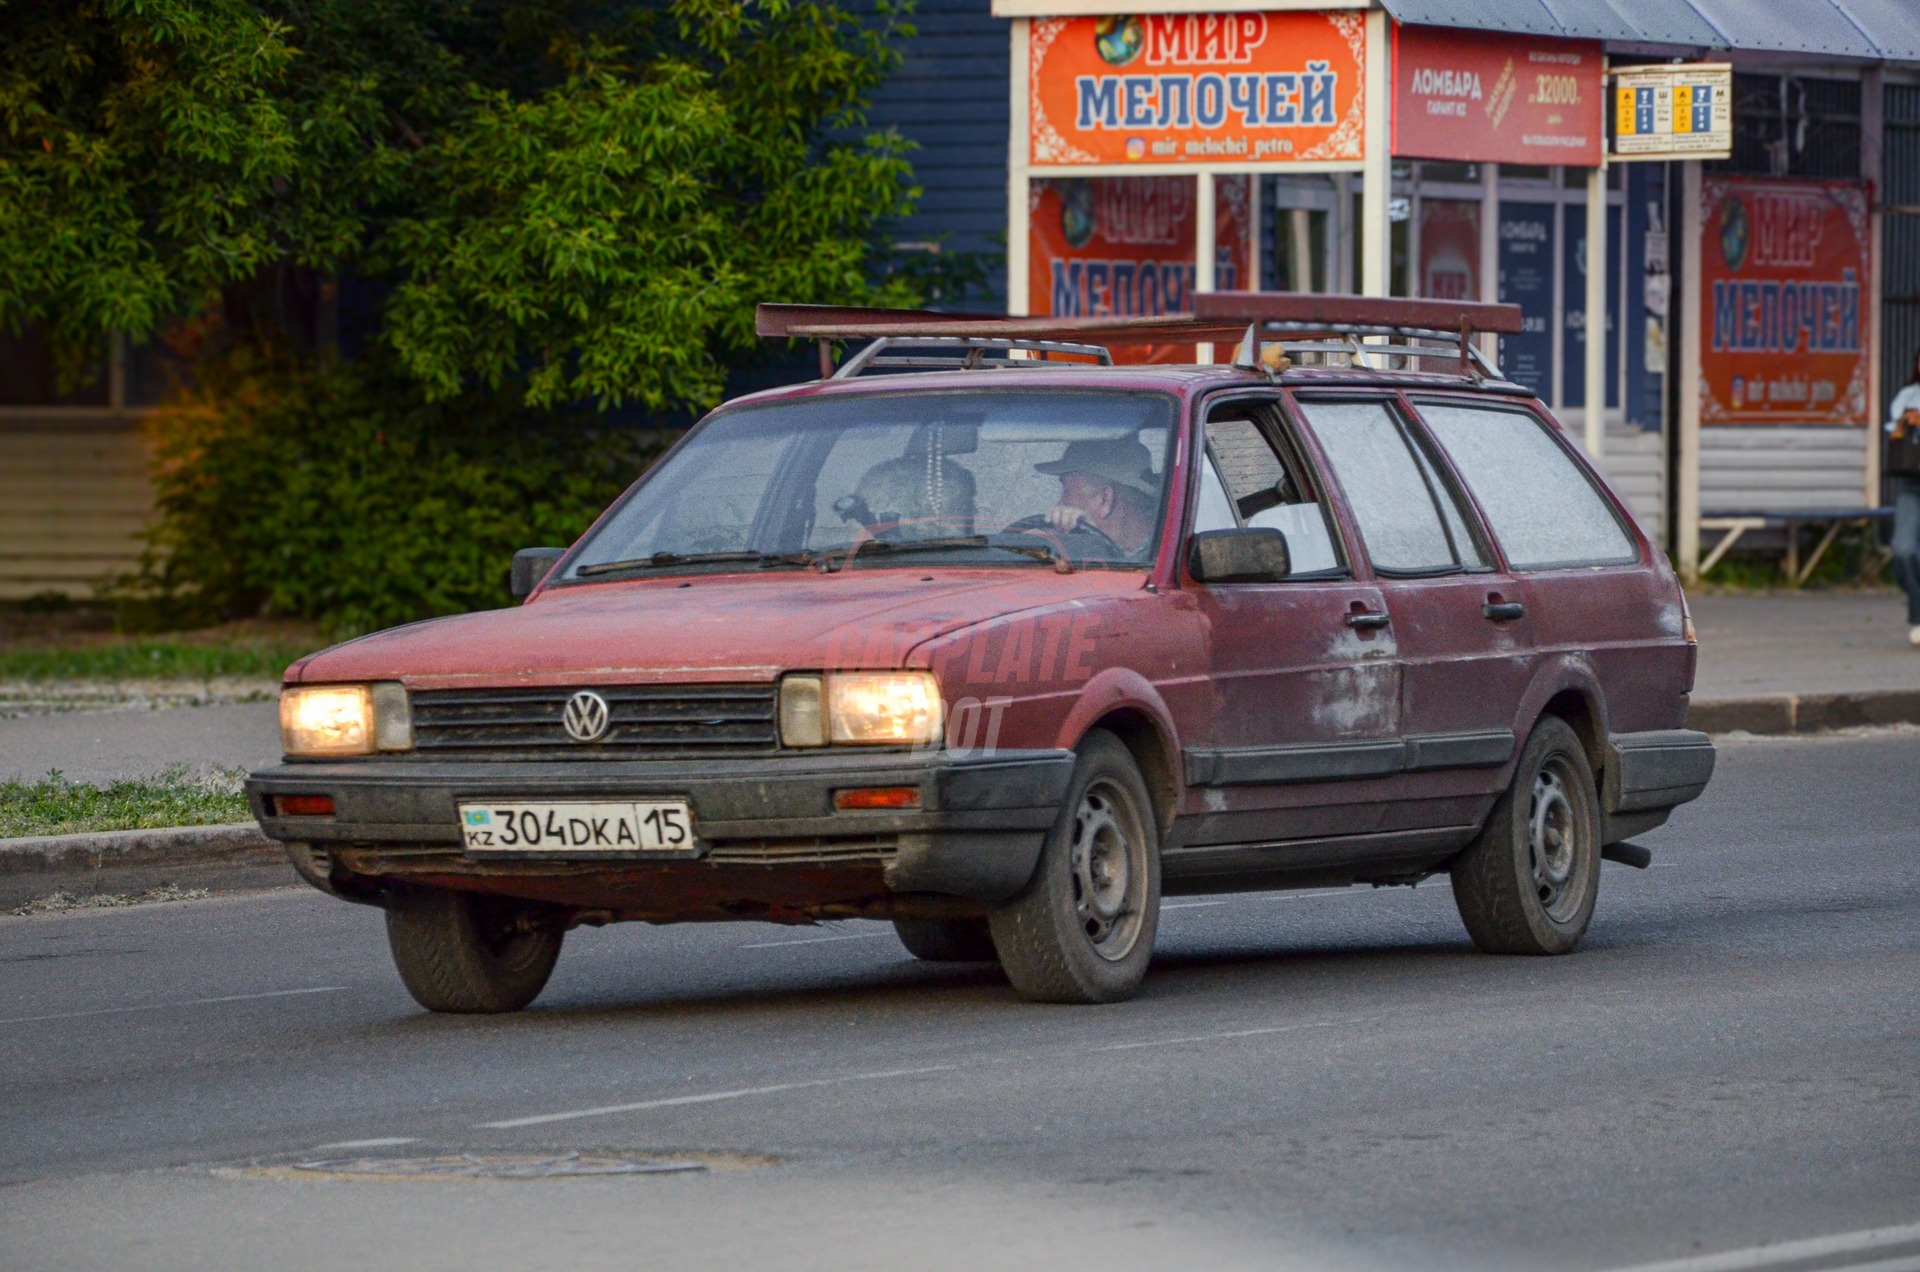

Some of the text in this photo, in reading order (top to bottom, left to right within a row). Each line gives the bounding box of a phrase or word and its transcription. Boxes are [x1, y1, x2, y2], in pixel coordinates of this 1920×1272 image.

[1146, 12, 1267, 65] МИР
[1076, 61, 1337, 129] МЕЛОЧЕЙ
[1754, 192, 1825, 266] МИР
[1712, 268, 1860, 353] МЕЛОЧЕЙ
[468, 831, 495, 846] KZ
